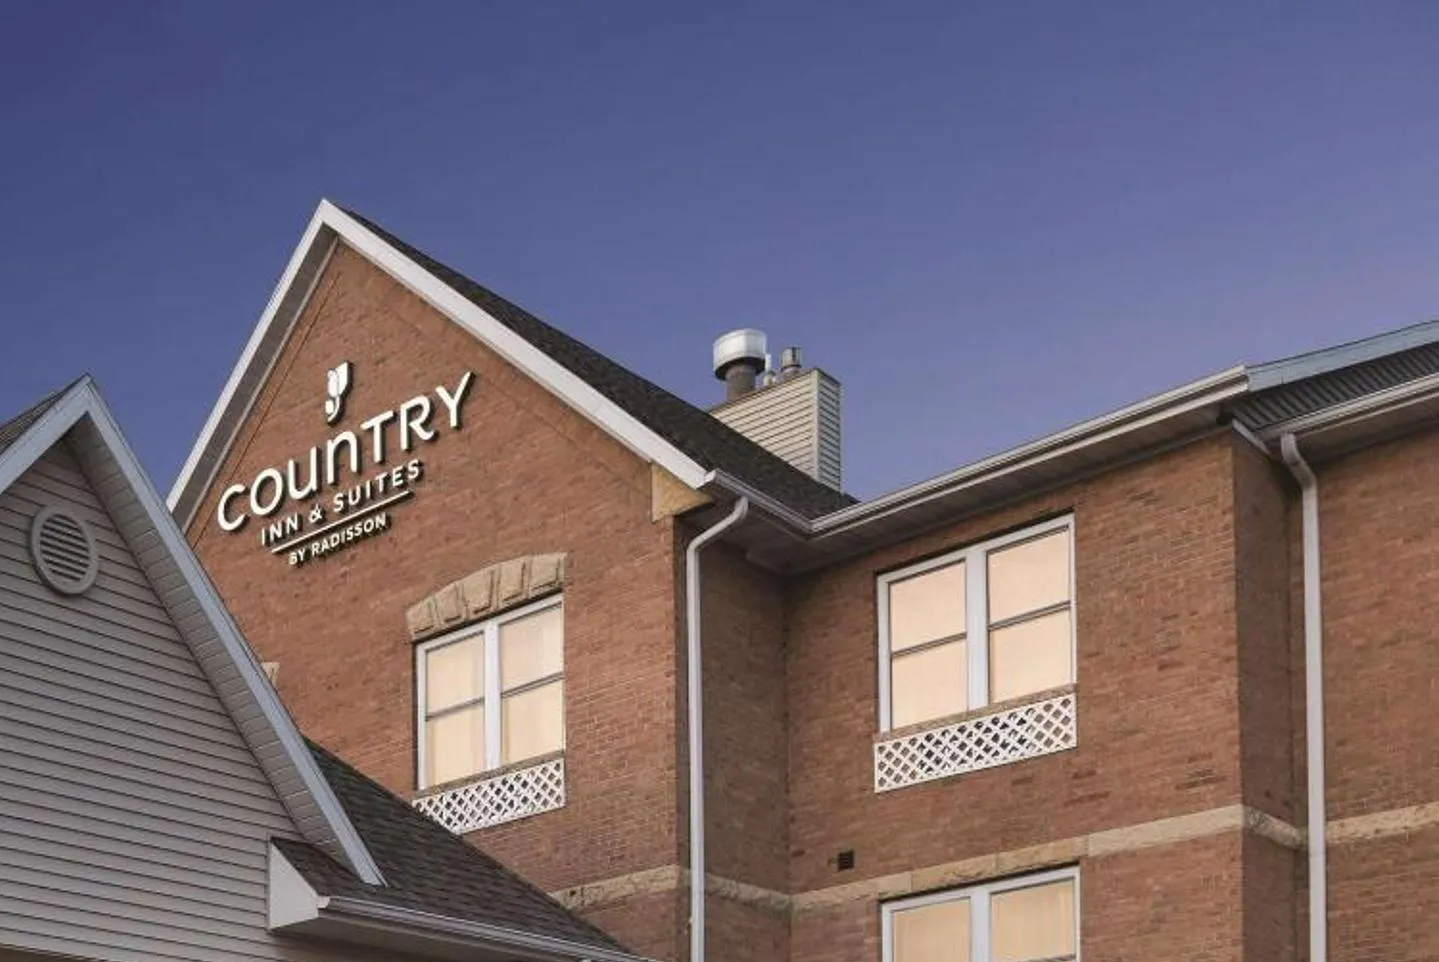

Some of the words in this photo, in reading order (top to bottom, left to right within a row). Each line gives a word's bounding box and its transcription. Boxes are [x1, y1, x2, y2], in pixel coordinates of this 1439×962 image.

[261, 513, 299, 546] INN
[308, 503, 323, 523] &
[333, 458, 420, 513] SUITES
[289, 551, 306, 566] BY
[311, 513, 387, 557] RADISSON
